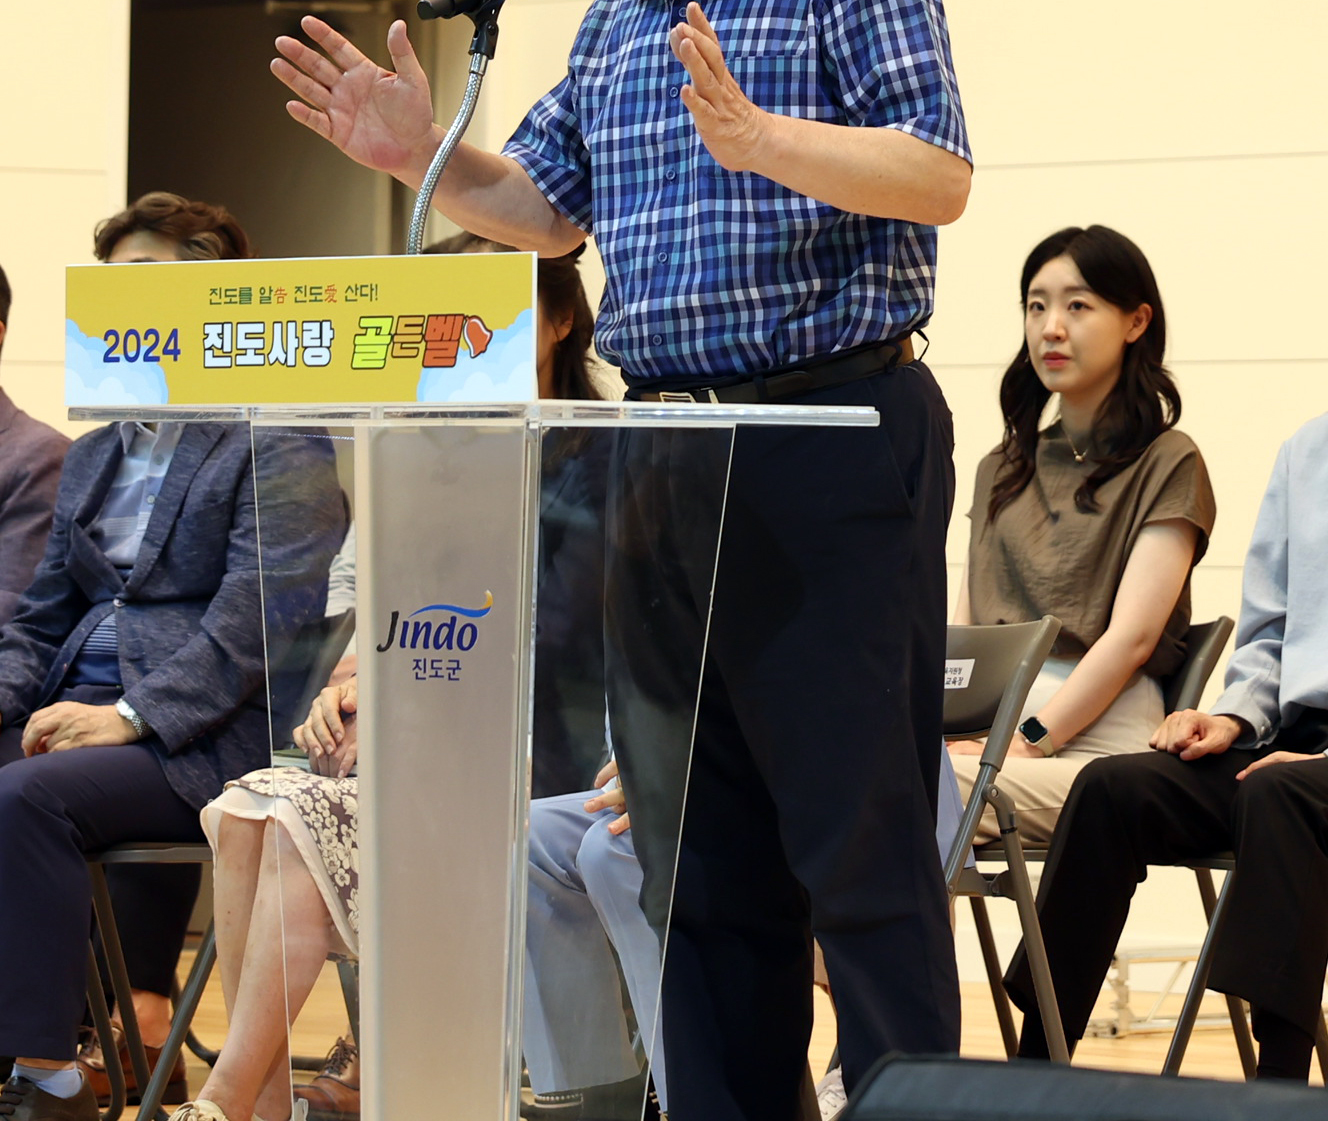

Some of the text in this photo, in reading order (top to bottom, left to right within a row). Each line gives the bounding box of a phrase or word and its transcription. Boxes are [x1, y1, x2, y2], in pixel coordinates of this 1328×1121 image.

[209, 286, 252, 306] 진도를
[294, 284, 337, 304] 진도愛
[344, 283, 378, 302] 산다!
[102, 314, 466, 370] 2024 진도사랑 골든벨
[376, 610, 478, 652] Jindo
[412, 657, 462, 681] 진도군
